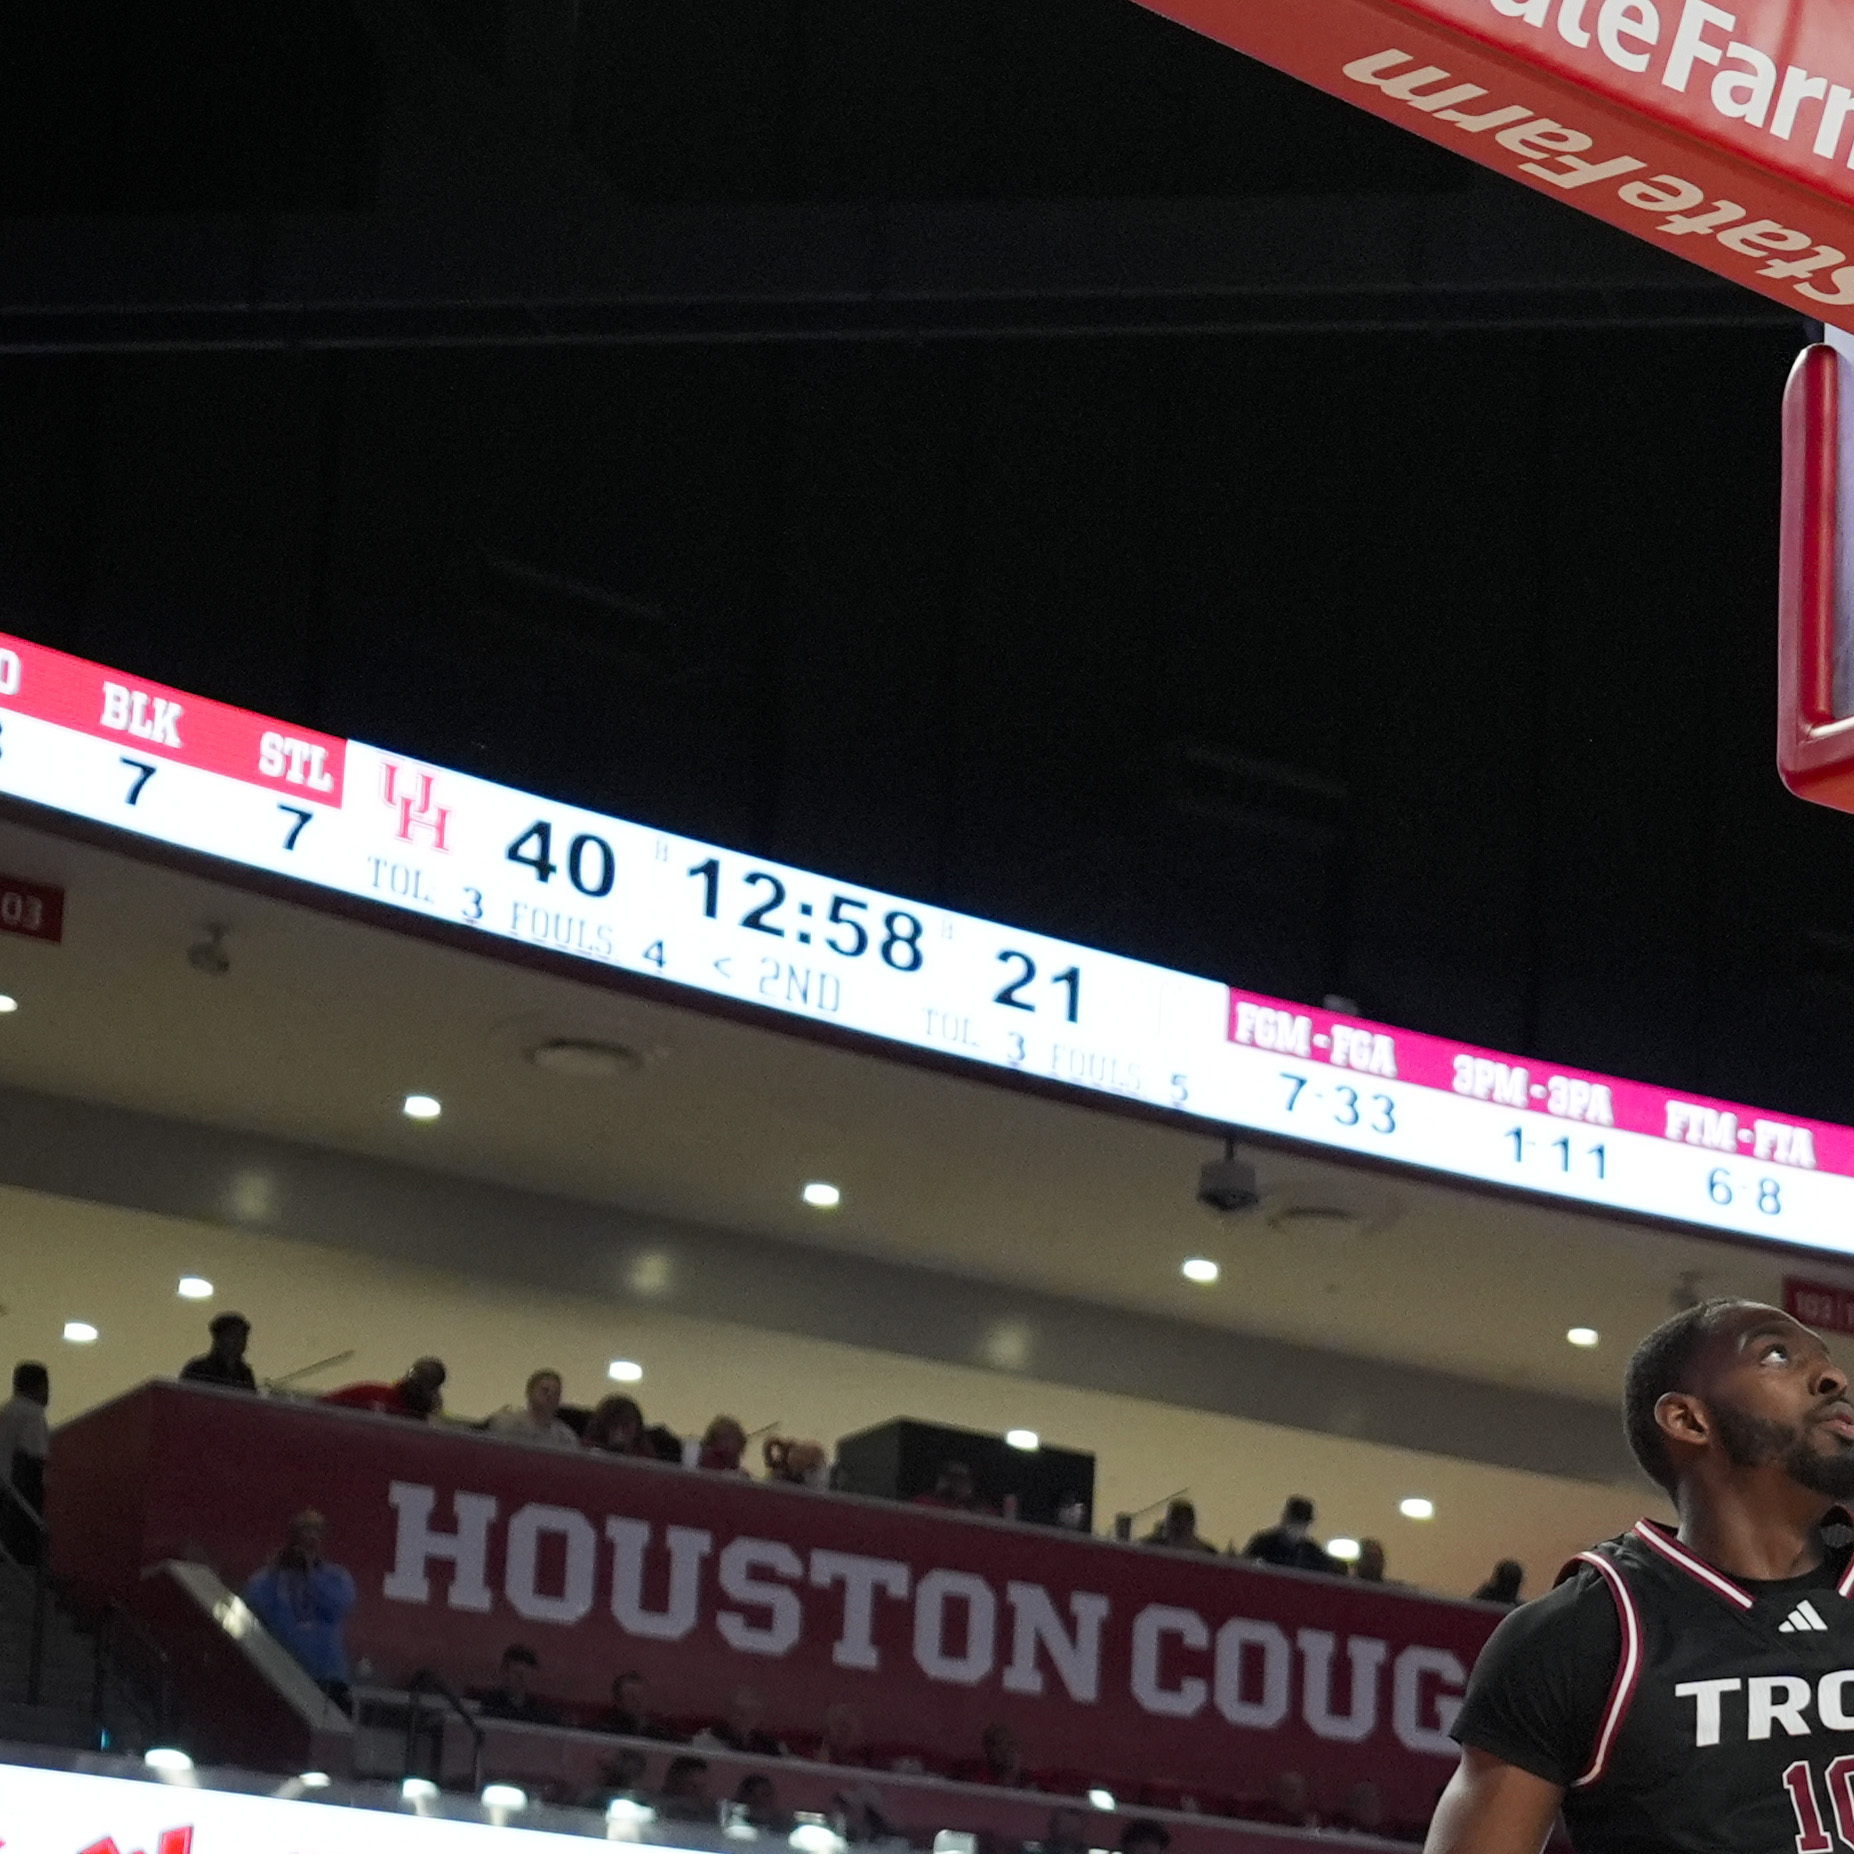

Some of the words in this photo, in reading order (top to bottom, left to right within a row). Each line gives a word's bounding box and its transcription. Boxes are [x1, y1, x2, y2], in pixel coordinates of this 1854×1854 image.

[101, 681, 183, 748] BLK
[258, 731, 334, 793] STL
[120, 756, 158, 807] 7
[277, 801, 314, 852] 7
[504, 818, 617, 899] 40
[462, 887, 485, 922] 3
[642, 938, 667, 969] 4
[685, 856, 924, 974] 12:58
[758, 955, 841, 1014] 2ND
[991, 947, 1081, 1025] 21
[1006, 1030, 1026, 1063] 3
[1169, 1072, 1189, 1102] 5
[383, 1481, 1111, 1704] HOUSTON
[1130, 1603, 1465, 1755] COUG
